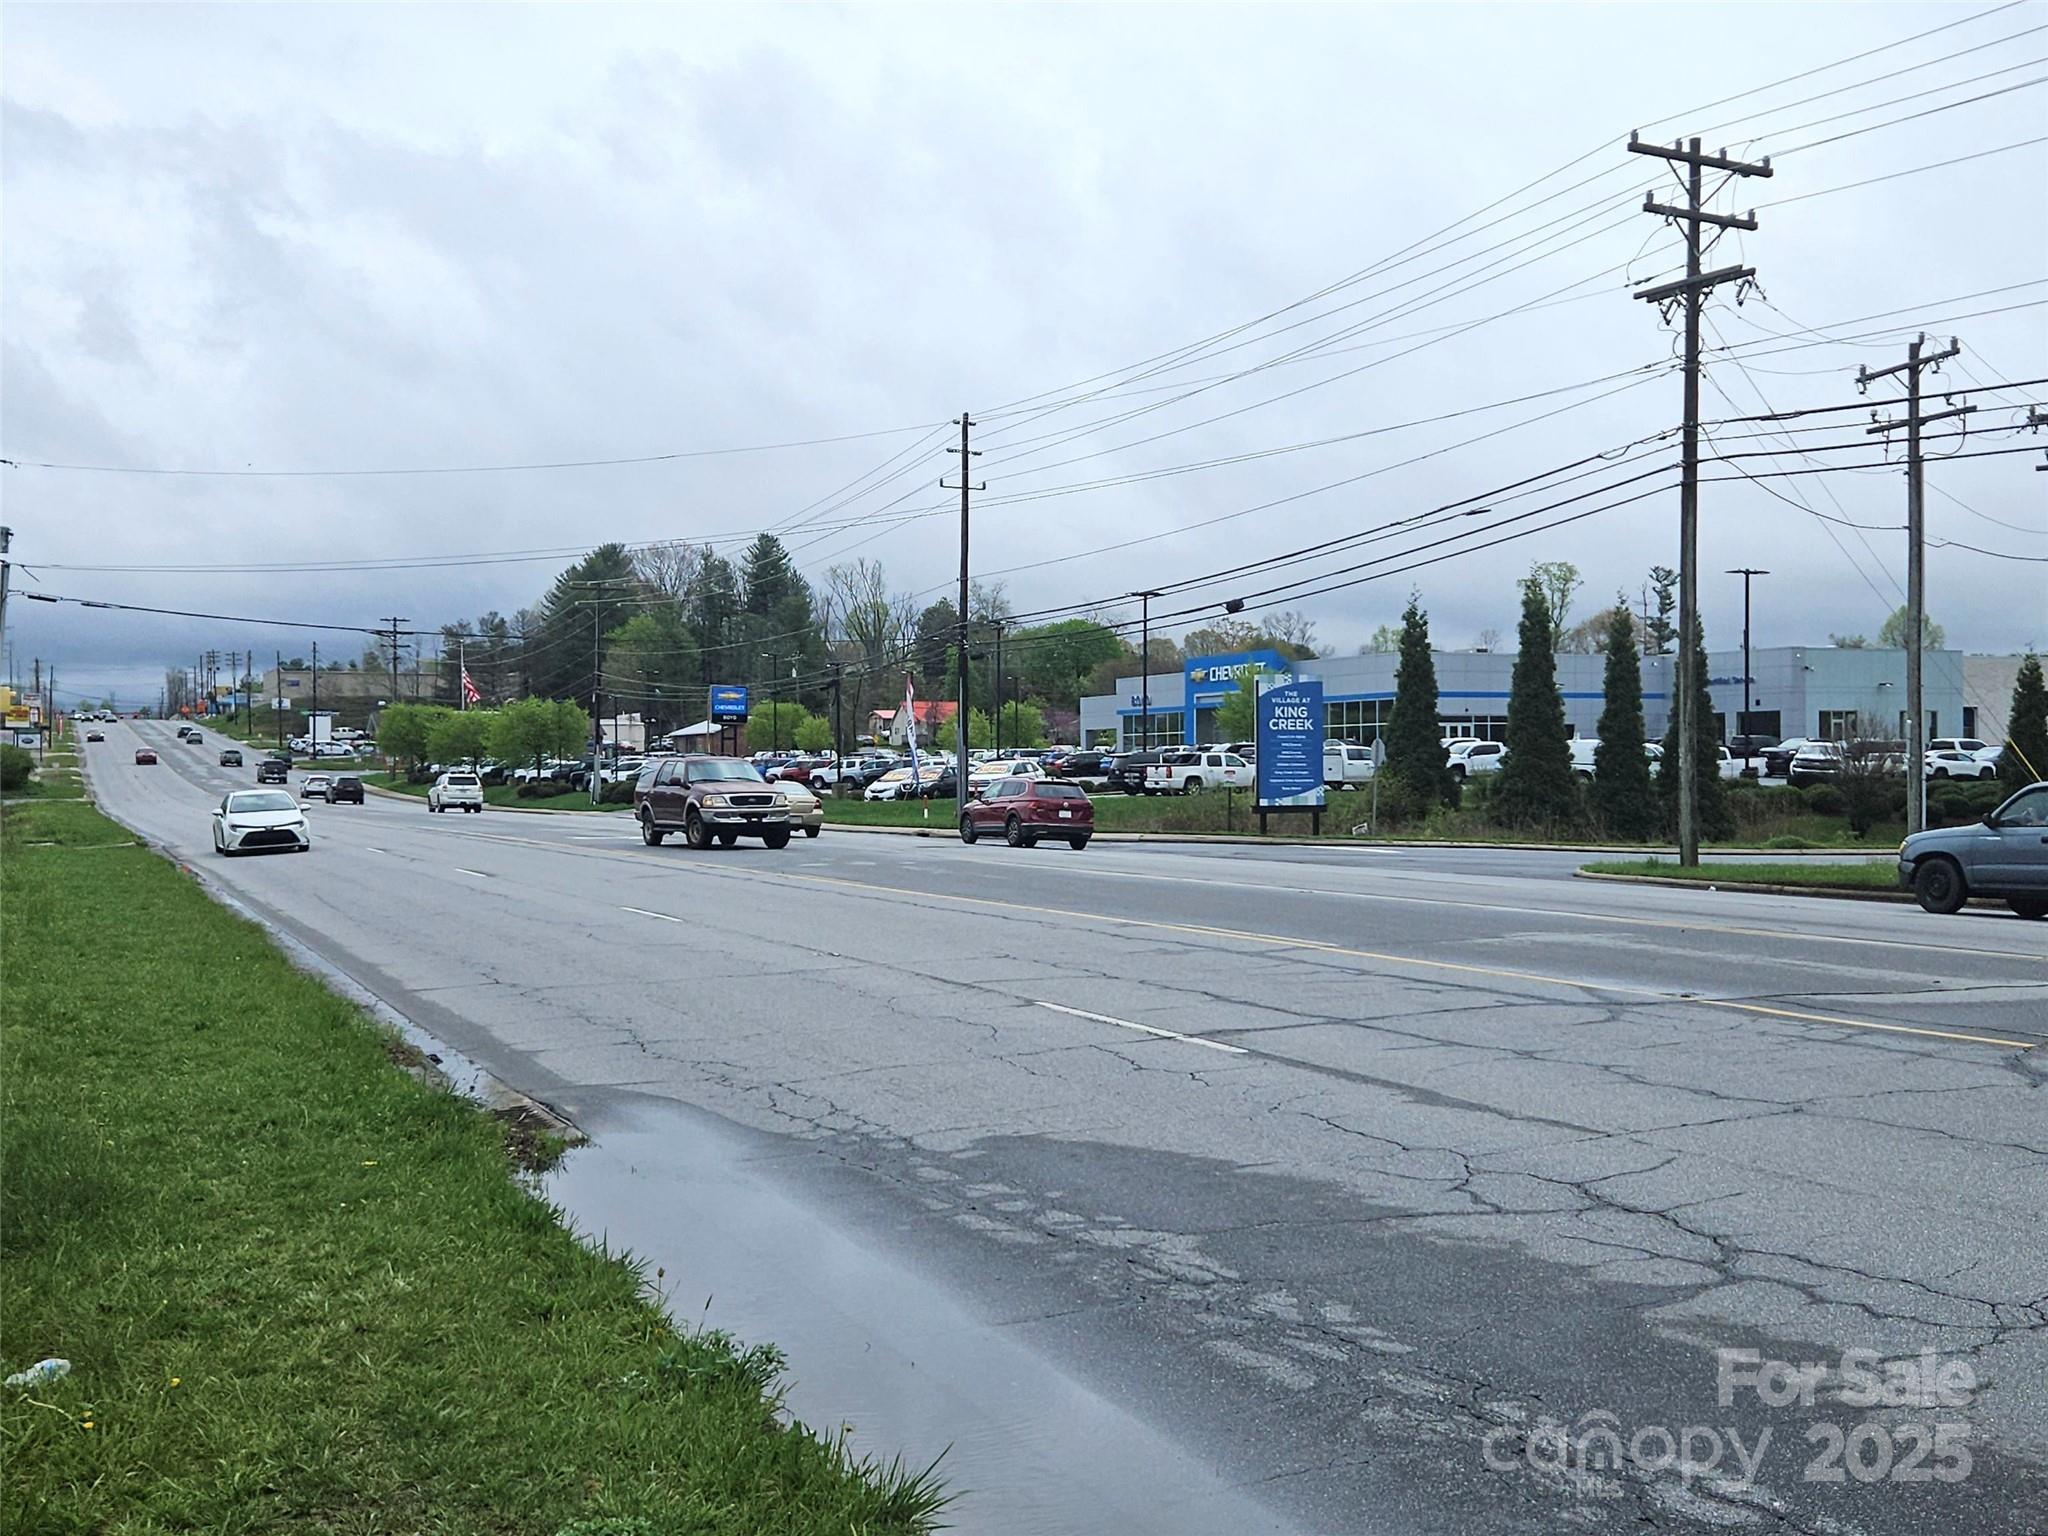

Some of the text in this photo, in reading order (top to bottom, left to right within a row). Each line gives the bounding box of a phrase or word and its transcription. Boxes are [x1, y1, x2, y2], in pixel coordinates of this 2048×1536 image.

[1209, 661, 1267, 682] CHEVROT
[1274, 706, 1308, 718] KING
[1268, 718, 1314, 730] CREEK
